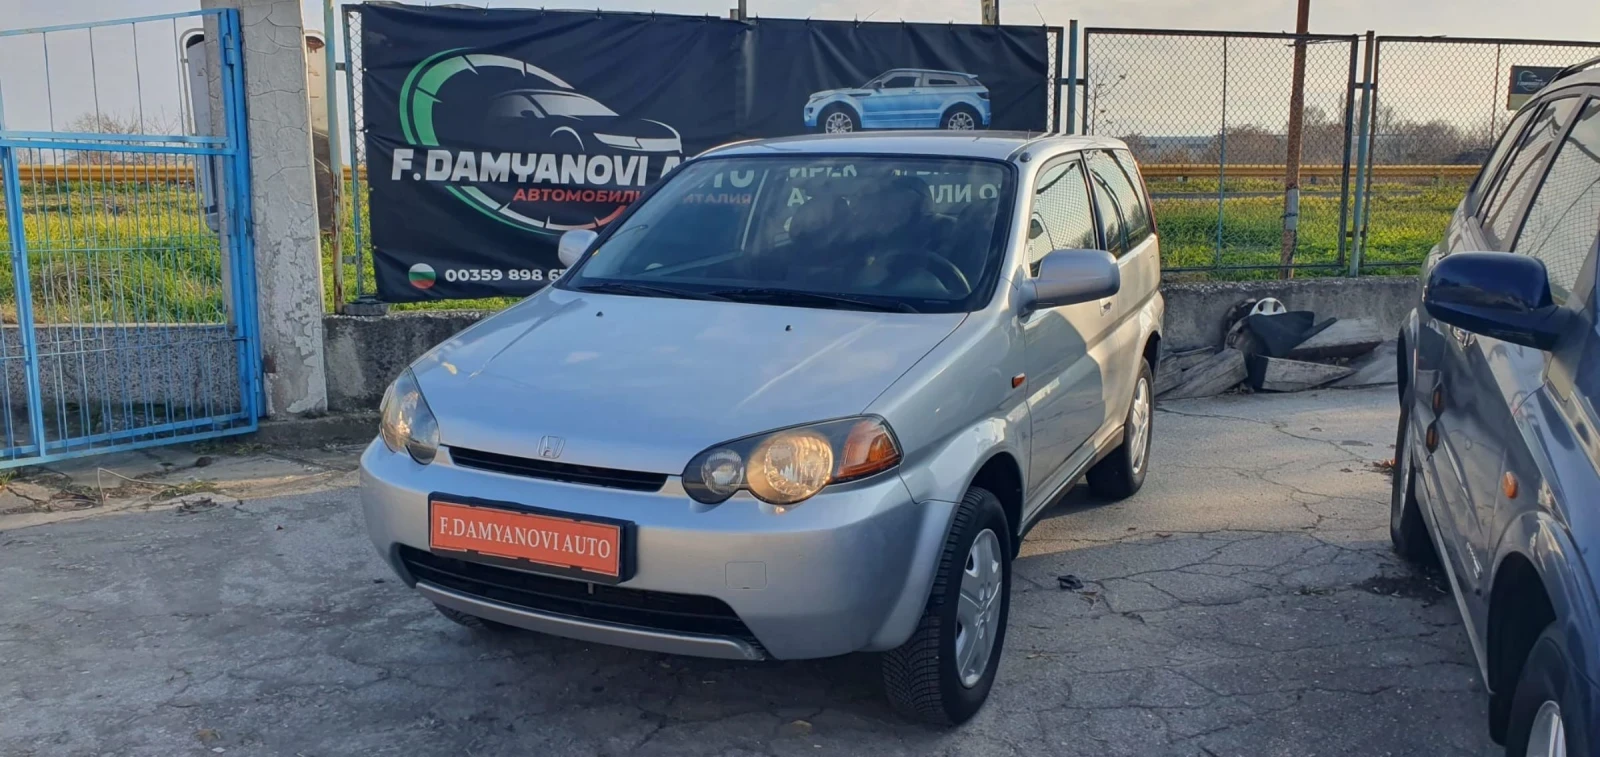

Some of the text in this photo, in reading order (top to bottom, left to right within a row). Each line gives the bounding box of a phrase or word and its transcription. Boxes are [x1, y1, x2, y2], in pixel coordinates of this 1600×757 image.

[391, 148, 649, 187] F.DAMYANOVI
[445, 269, 503, 282] 00359
[508, 269, 543, 282] 898
[439, 516, 612, 559] F.DAMYANOVI AUTO
